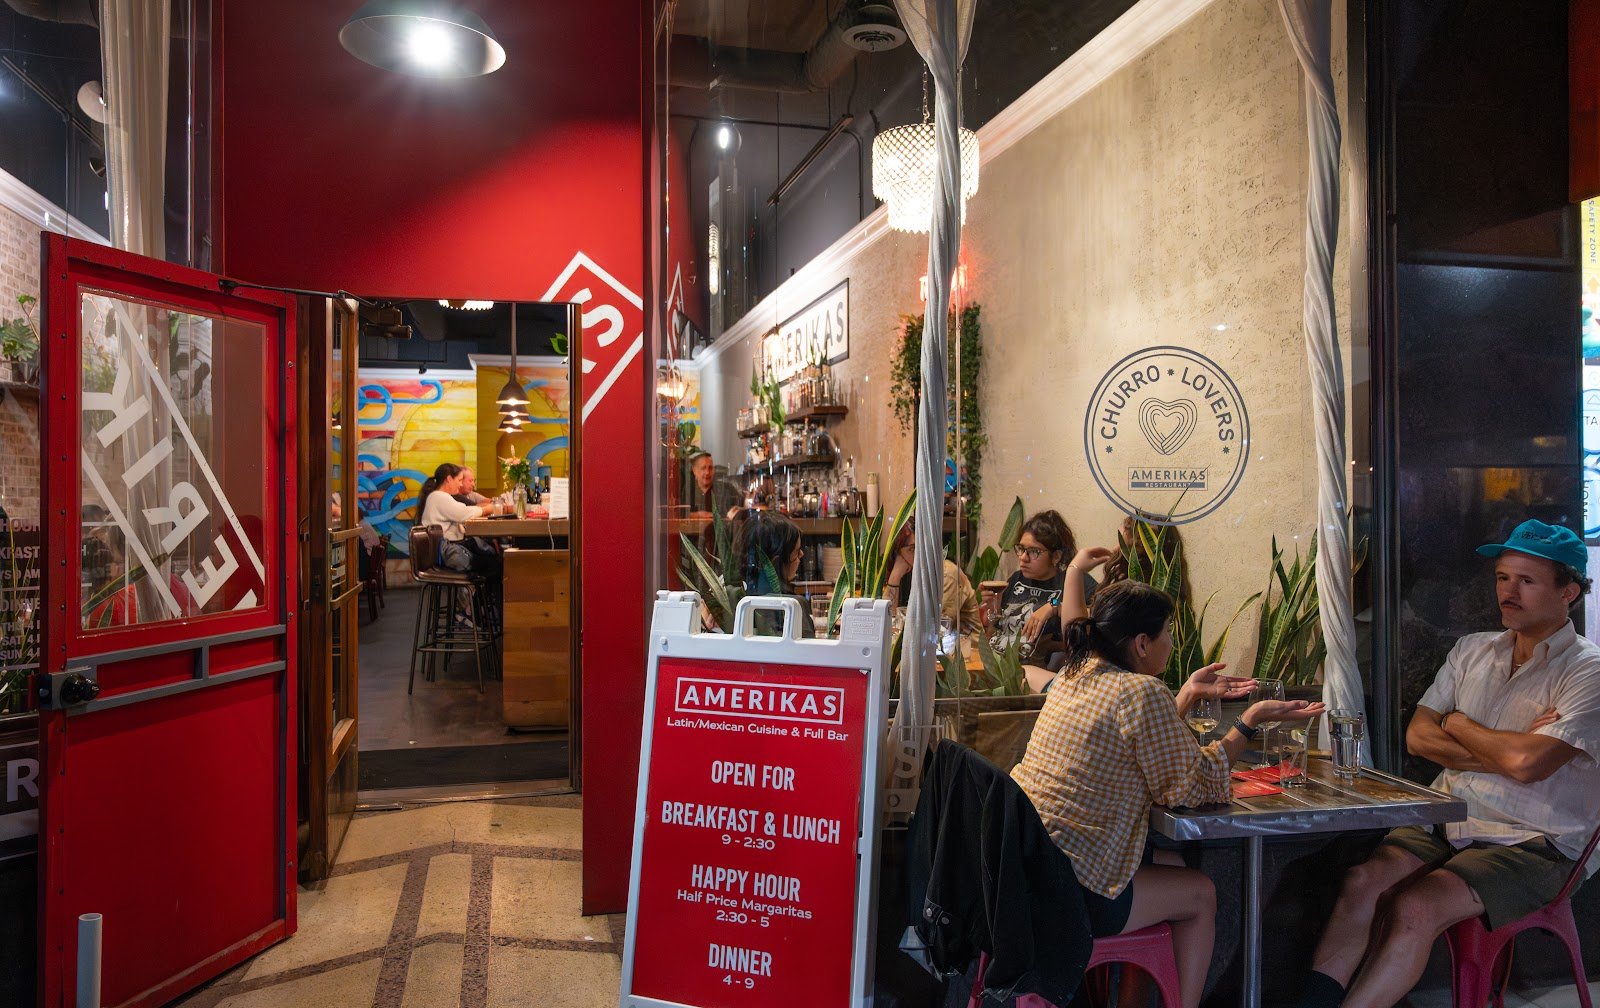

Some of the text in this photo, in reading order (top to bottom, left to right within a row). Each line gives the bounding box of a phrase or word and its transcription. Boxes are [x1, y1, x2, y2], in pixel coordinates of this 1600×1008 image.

[1589, 238, 1597, 264] ZONE
[1100, 365, 1235, 442] CHURRO LOVERS
[1131, 470, 1206, 480] AMERIKAS
[682, 685, 837, 716] AMERIKAS
[666, 717, 849, 741] Latin/Mexican Cuisine & Full Bar
[711, 760, 795, 791] OPEN FOR
[661, 800, 841, 844] BREAKFAST & LUNCH
[721, 834, 732, 845] 9
[743, 836, 775, 850] 2:30
[691, 864, 801, 902] HAPPY HOUR
[677, 889, 813, 919] Half Price Margaritas
[716, 910, 748, 924] 2:30
[760, 916, 770, 928] 5
[708, 943, 772, 977] DINNER
[722, 974, 732, 986] 4
[744, 977, 755, 989] 9
